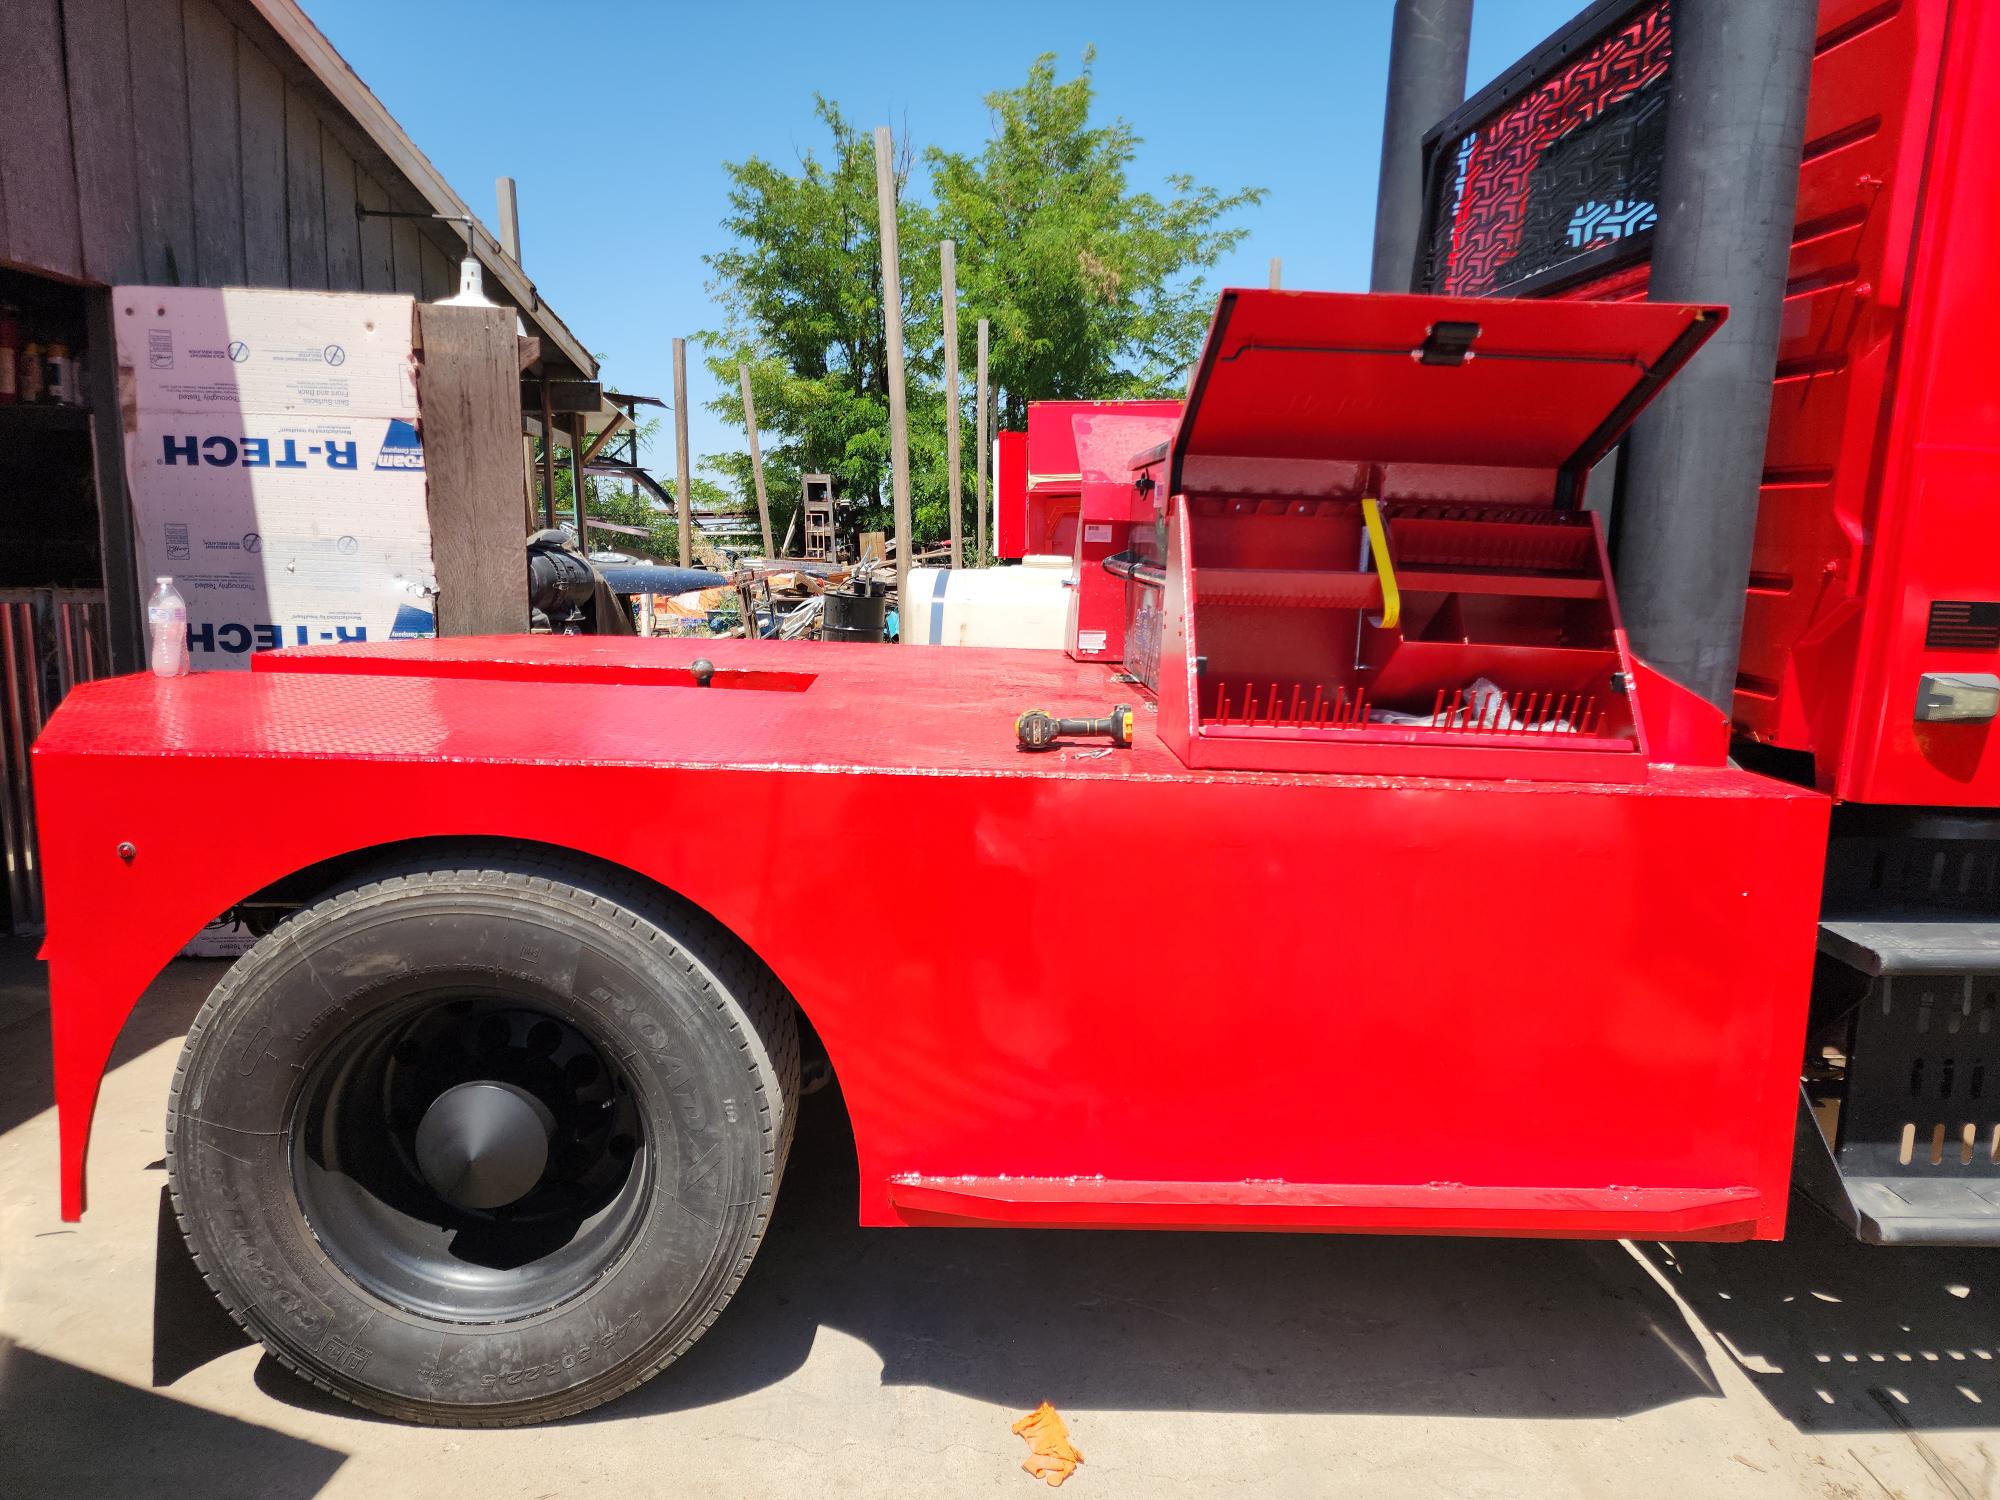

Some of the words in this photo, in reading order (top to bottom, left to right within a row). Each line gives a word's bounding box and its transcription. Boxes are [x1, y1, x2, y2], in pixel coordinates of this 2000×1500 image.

[179, 393, 201, 401] Tested
[203, 394, 239, 402] Thoroughly
[162, 434, 358, 470] R-TECH
[382, 446, 410, 455] Company
[194, 582, 216, 590] Tested
[219, 582, 256, 591] Thoroughly
